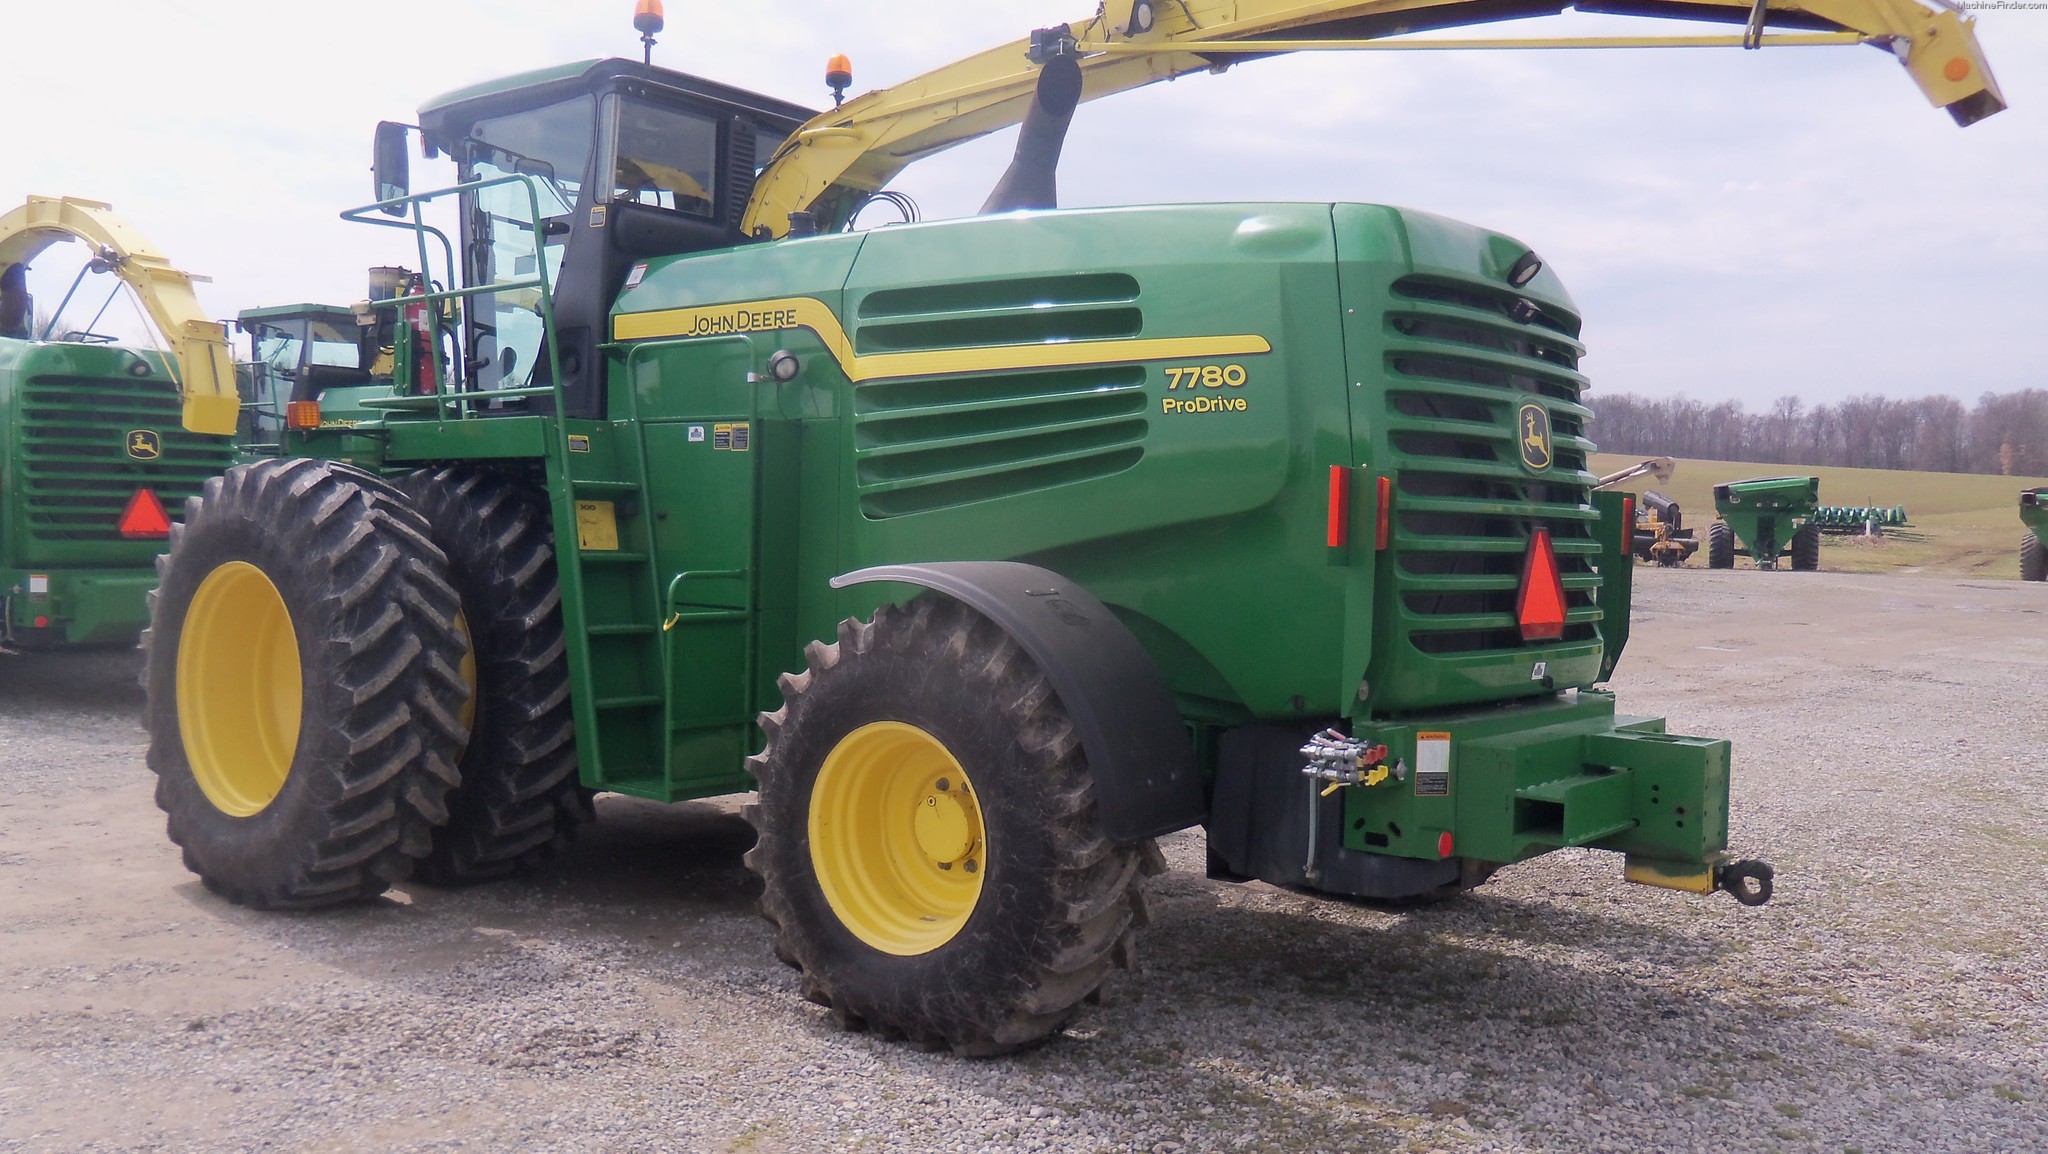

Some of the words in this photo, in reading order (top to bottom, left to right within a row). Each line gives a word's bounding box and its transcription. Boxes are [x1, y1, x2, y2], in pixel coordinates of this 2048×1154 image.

[688, 315, 734, 334] JOHN
[737, 309, 797, 330] DEERE
[1164, 364, 1247, 389] 7780
[1162, 395, 1248, 414] ProDrive
